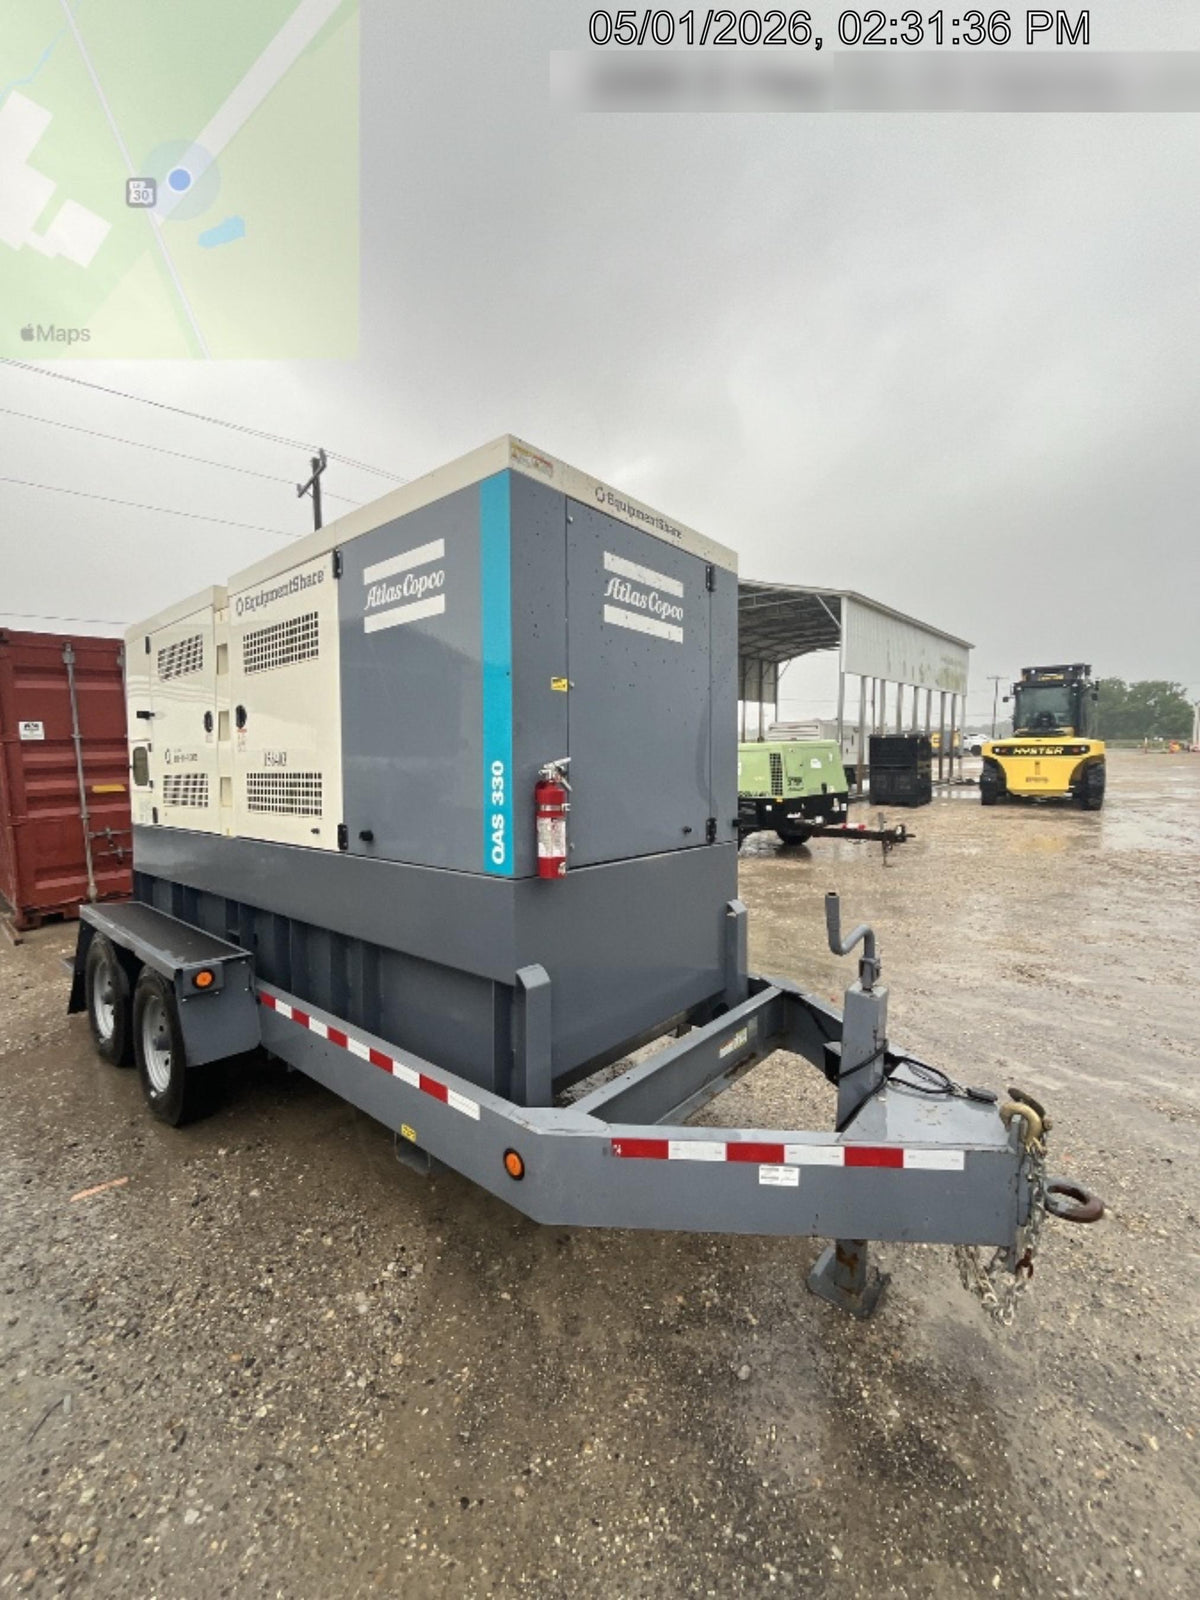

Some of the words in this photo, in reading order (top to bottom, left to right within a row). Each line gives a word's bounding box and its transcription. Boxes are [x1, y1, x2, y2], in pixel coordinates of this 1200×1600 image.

[244, 570, 324, 612] EquipmentShare
[363, 583, 402, 610] Atlas
[403, 570, 445, 598] Copco
[604, 577, 648, 609] Atlas
[648, 591, 684, 621] Copco
[1013, 746, 1064, 755] HYSTER
[491, 760, 504, 806] 330
[491, 813, 505, 865] QAS
